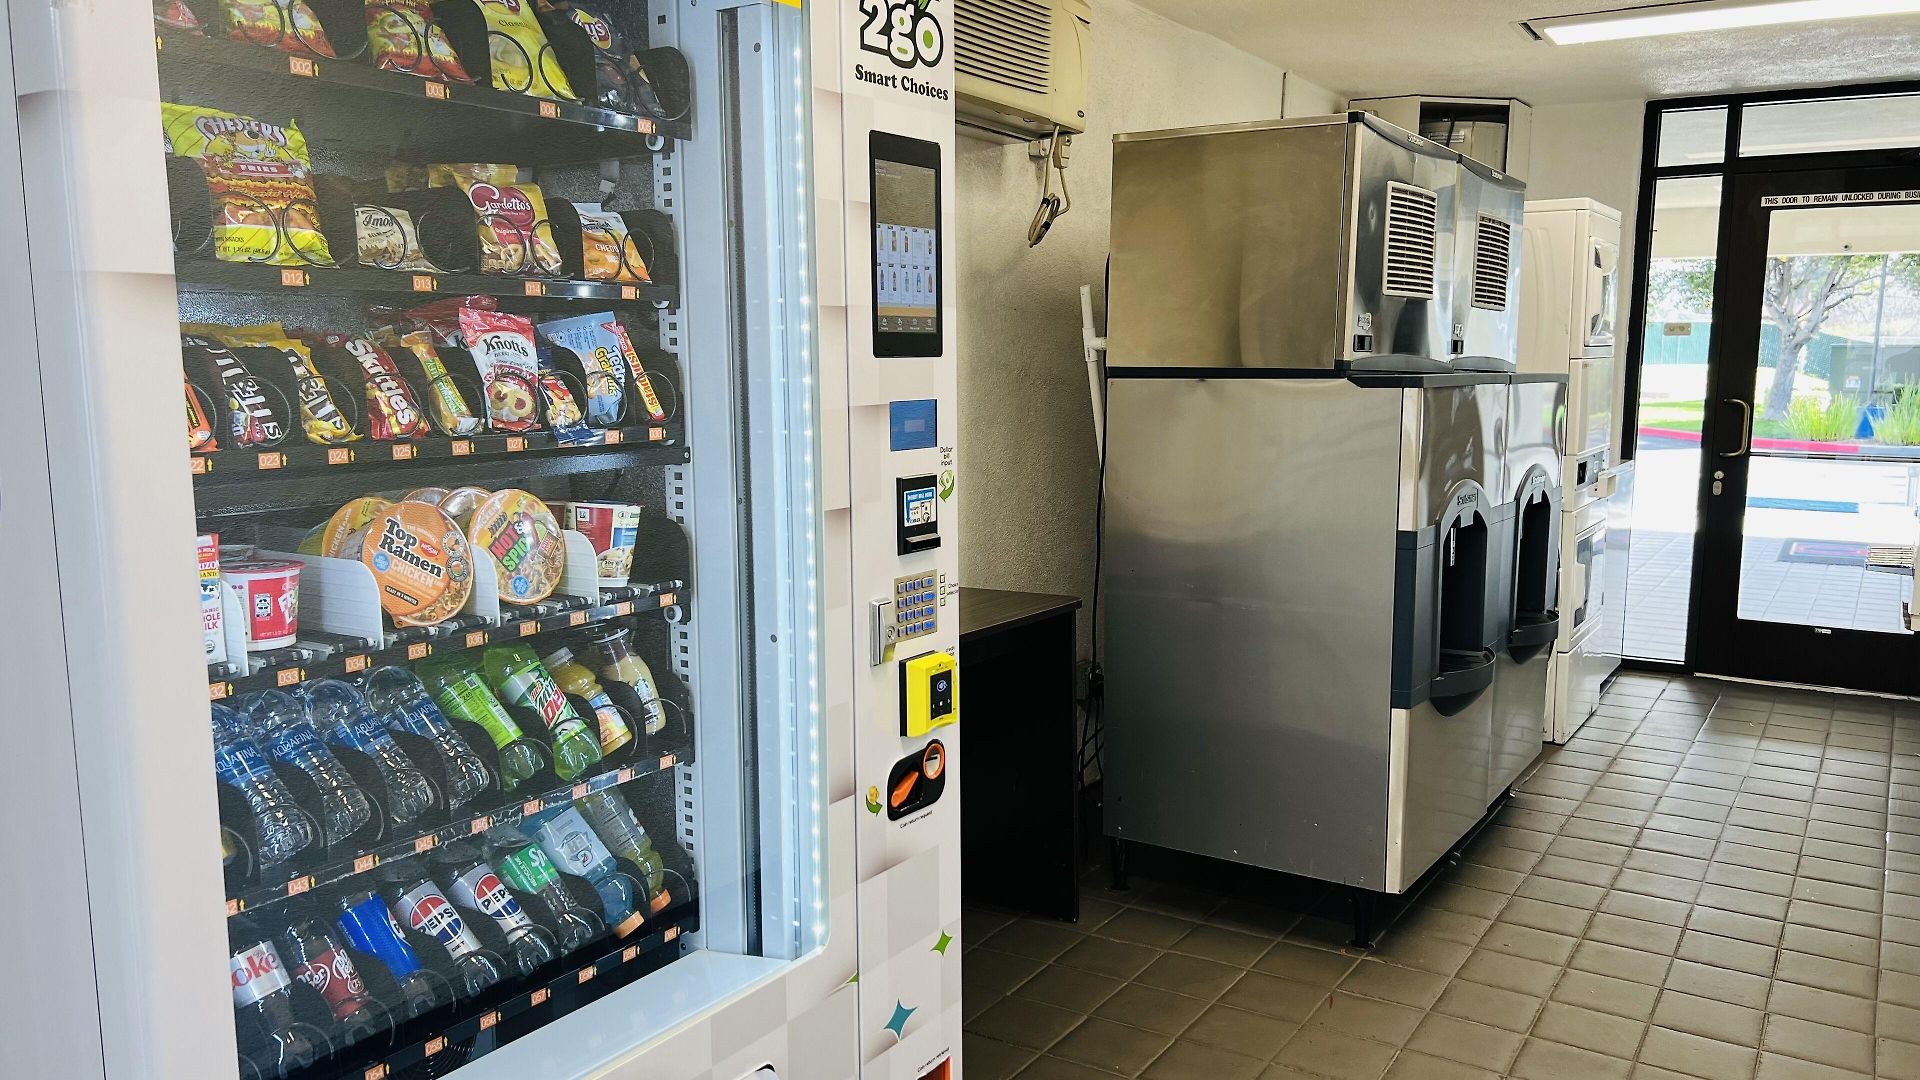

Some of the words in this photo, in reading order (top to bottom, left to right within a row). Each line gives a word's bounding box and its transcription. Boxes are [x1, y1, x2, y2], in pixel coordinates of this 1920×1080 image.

[861, 0, 943, 67] 2go
[292, 61, 311, 74] 002
[855, 64, 898, 89] Smart
[900, 75, 949, 101] Choices
[427, 85, 444, 96] 003
[541, 104, 556, 116] 004
[1764, 197, 1778, 205] THIS
[1813, 195, 1838, 203] REMAIN
[1841, 193, 1874, 201] UNLOCKED
[1877, 191, 1901, 200] DURING
[284, 272, 303, 284] 012
[414, 280, 431, 289] 013
[527, 285, 541, 293] 014
[453, 443, 470, 454] 026
[508, 439, 523, 448] 027
[392, 447, 412, 458] 025
[940, 446, 953, 454] Dollar
[259, 456, 280, 466] 023
[329, 451, 348, 462] 024
[191, 460, 206, 470] 22
[940, 459, 953, 467] input
[386, 517, 418, 549] Top
[491, 526, 520, 558] HOT
[378, 533, 442, 579] Ramen
[502, 536, 529, 571] SPIC
[391, 560, 433, 587] CHICKEN
[522, 622, 536, 634] 037
[410, 645, 426, 658] 035
[347, 658, 364, 671] 034
[279, 671, 299, 684] 033
[209, 683, 226, 698] 32
[462, 691, 473, 701] 240
[272, 729, 315, 761] AQUAFINA
[416, 837, 433, 849] 045
[355, 858, 373, 871] 044
[289, 879, 309, 893] 043
[451, 942, 465, 953] DIET
[532, 992, 545, 1004] 057
